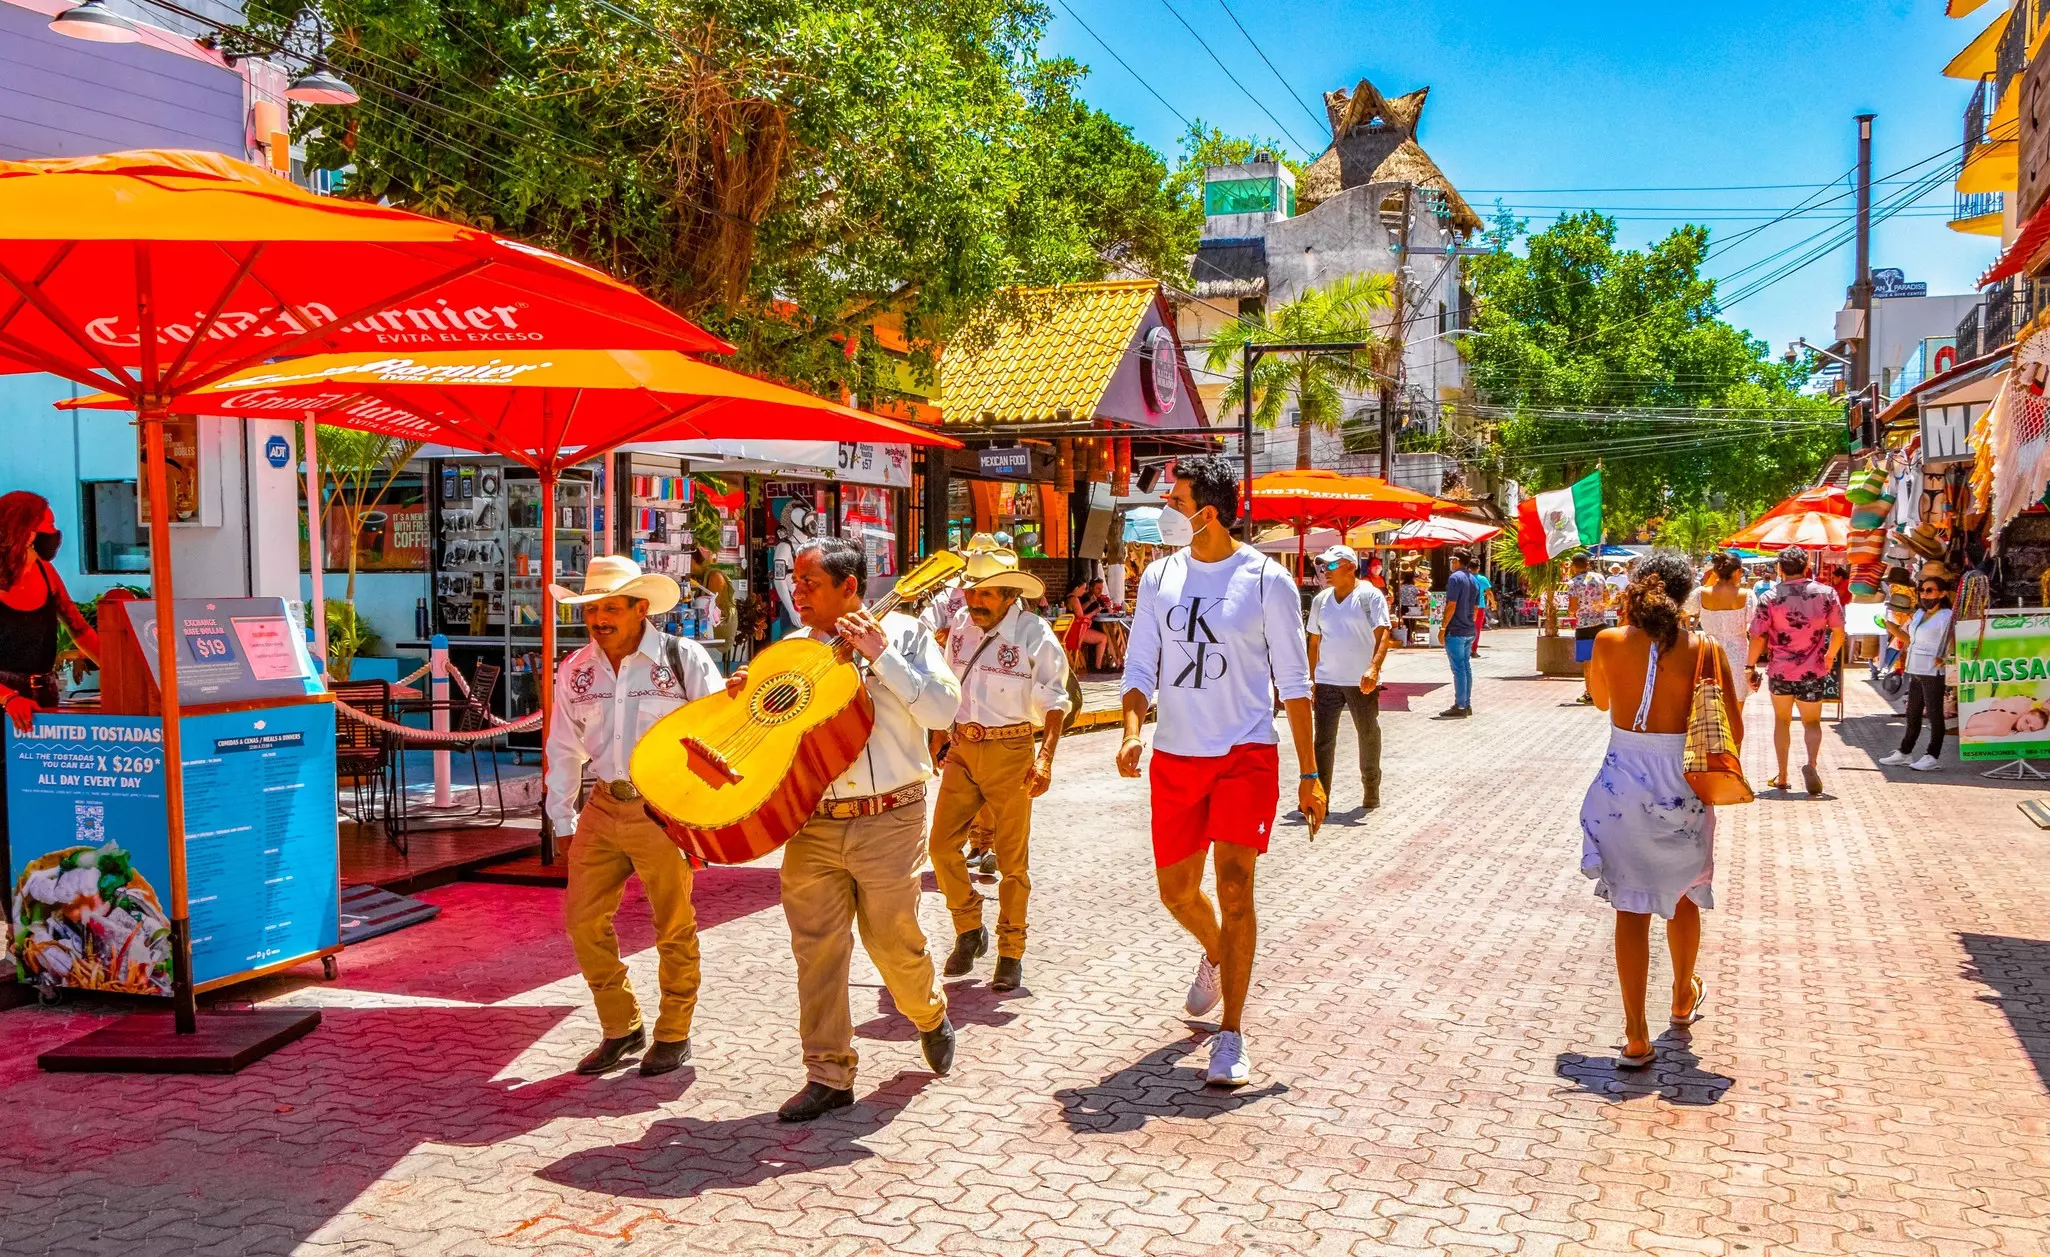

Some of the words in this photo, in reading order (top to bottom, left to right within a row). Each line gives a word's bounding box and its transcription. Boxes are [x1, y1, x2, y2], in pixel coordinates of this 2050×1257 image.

[1894, 283, 1926, 291] PARADISE
[377, 333, 434, 344] EVITA
[438, 333, 462, 342] EL
[469, 332, 544, 341] EXCESO
[269, 446, 287, 459] ADT
[838, 440, 858, 470] 57
[862, 458, 873, 470] $57
[980, 456, 1009, 467] MEXICAN
[1009, 454, 1026, 465] FOOD
[404, 513, 411, 521] A
[410, 513, 423, 522] NEW
[393, 521, 411, 532] WITH
[183, 618, 218, 627] EXCHANGE
[183, 628, 201, 636] RATE
[199, 627, 226, 636] DOLLAR
[196, 637, 227, 658] $19
[1959, 657, 2050, 684] MASSA
[19, 752, 34, 760] ALL
[53, 753, 95, 762] TOSTADAS
[97, 755, 108, 772] X
[60, 761, 78, 769] CAN
[38, 774, 57, 785] ALL
[60, 774, 81, 786] DAY
[84, 775, 118, 787] EVERY
[120, 777, 142, 788] DAY
